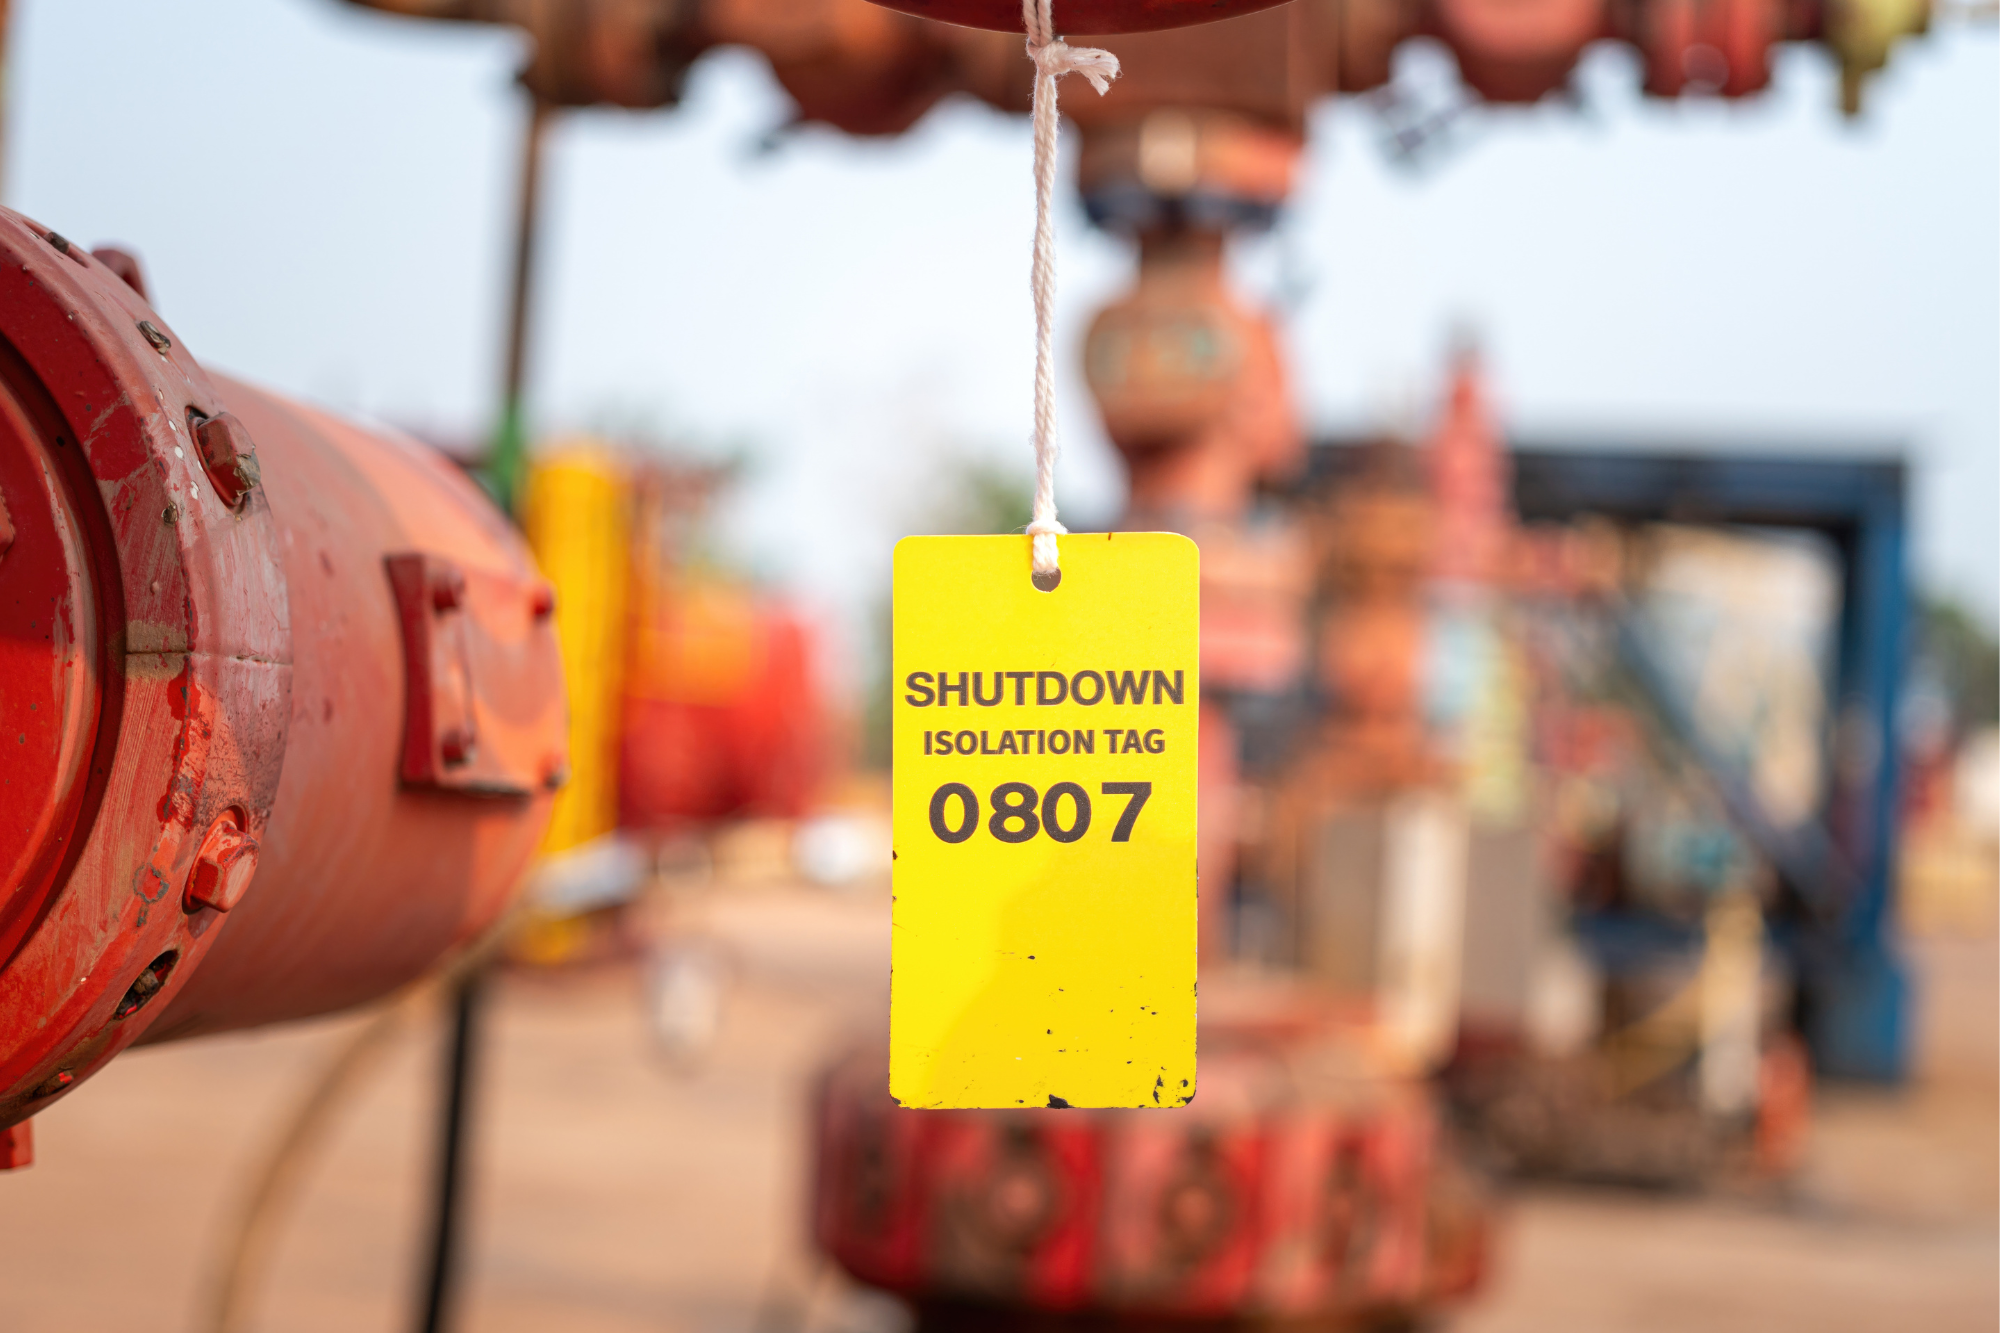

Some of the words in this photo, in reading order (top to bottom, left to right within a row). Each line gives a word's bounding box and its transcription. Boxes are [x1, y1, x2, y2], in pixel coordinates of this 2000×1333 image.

[905, 669, 1185, 707] SHUTDOWN
[923, 729, 1094, 756] ISOLATION
[1103, 728, 1166, 755] TAG
[928, 781, 1153, 845] 0807
